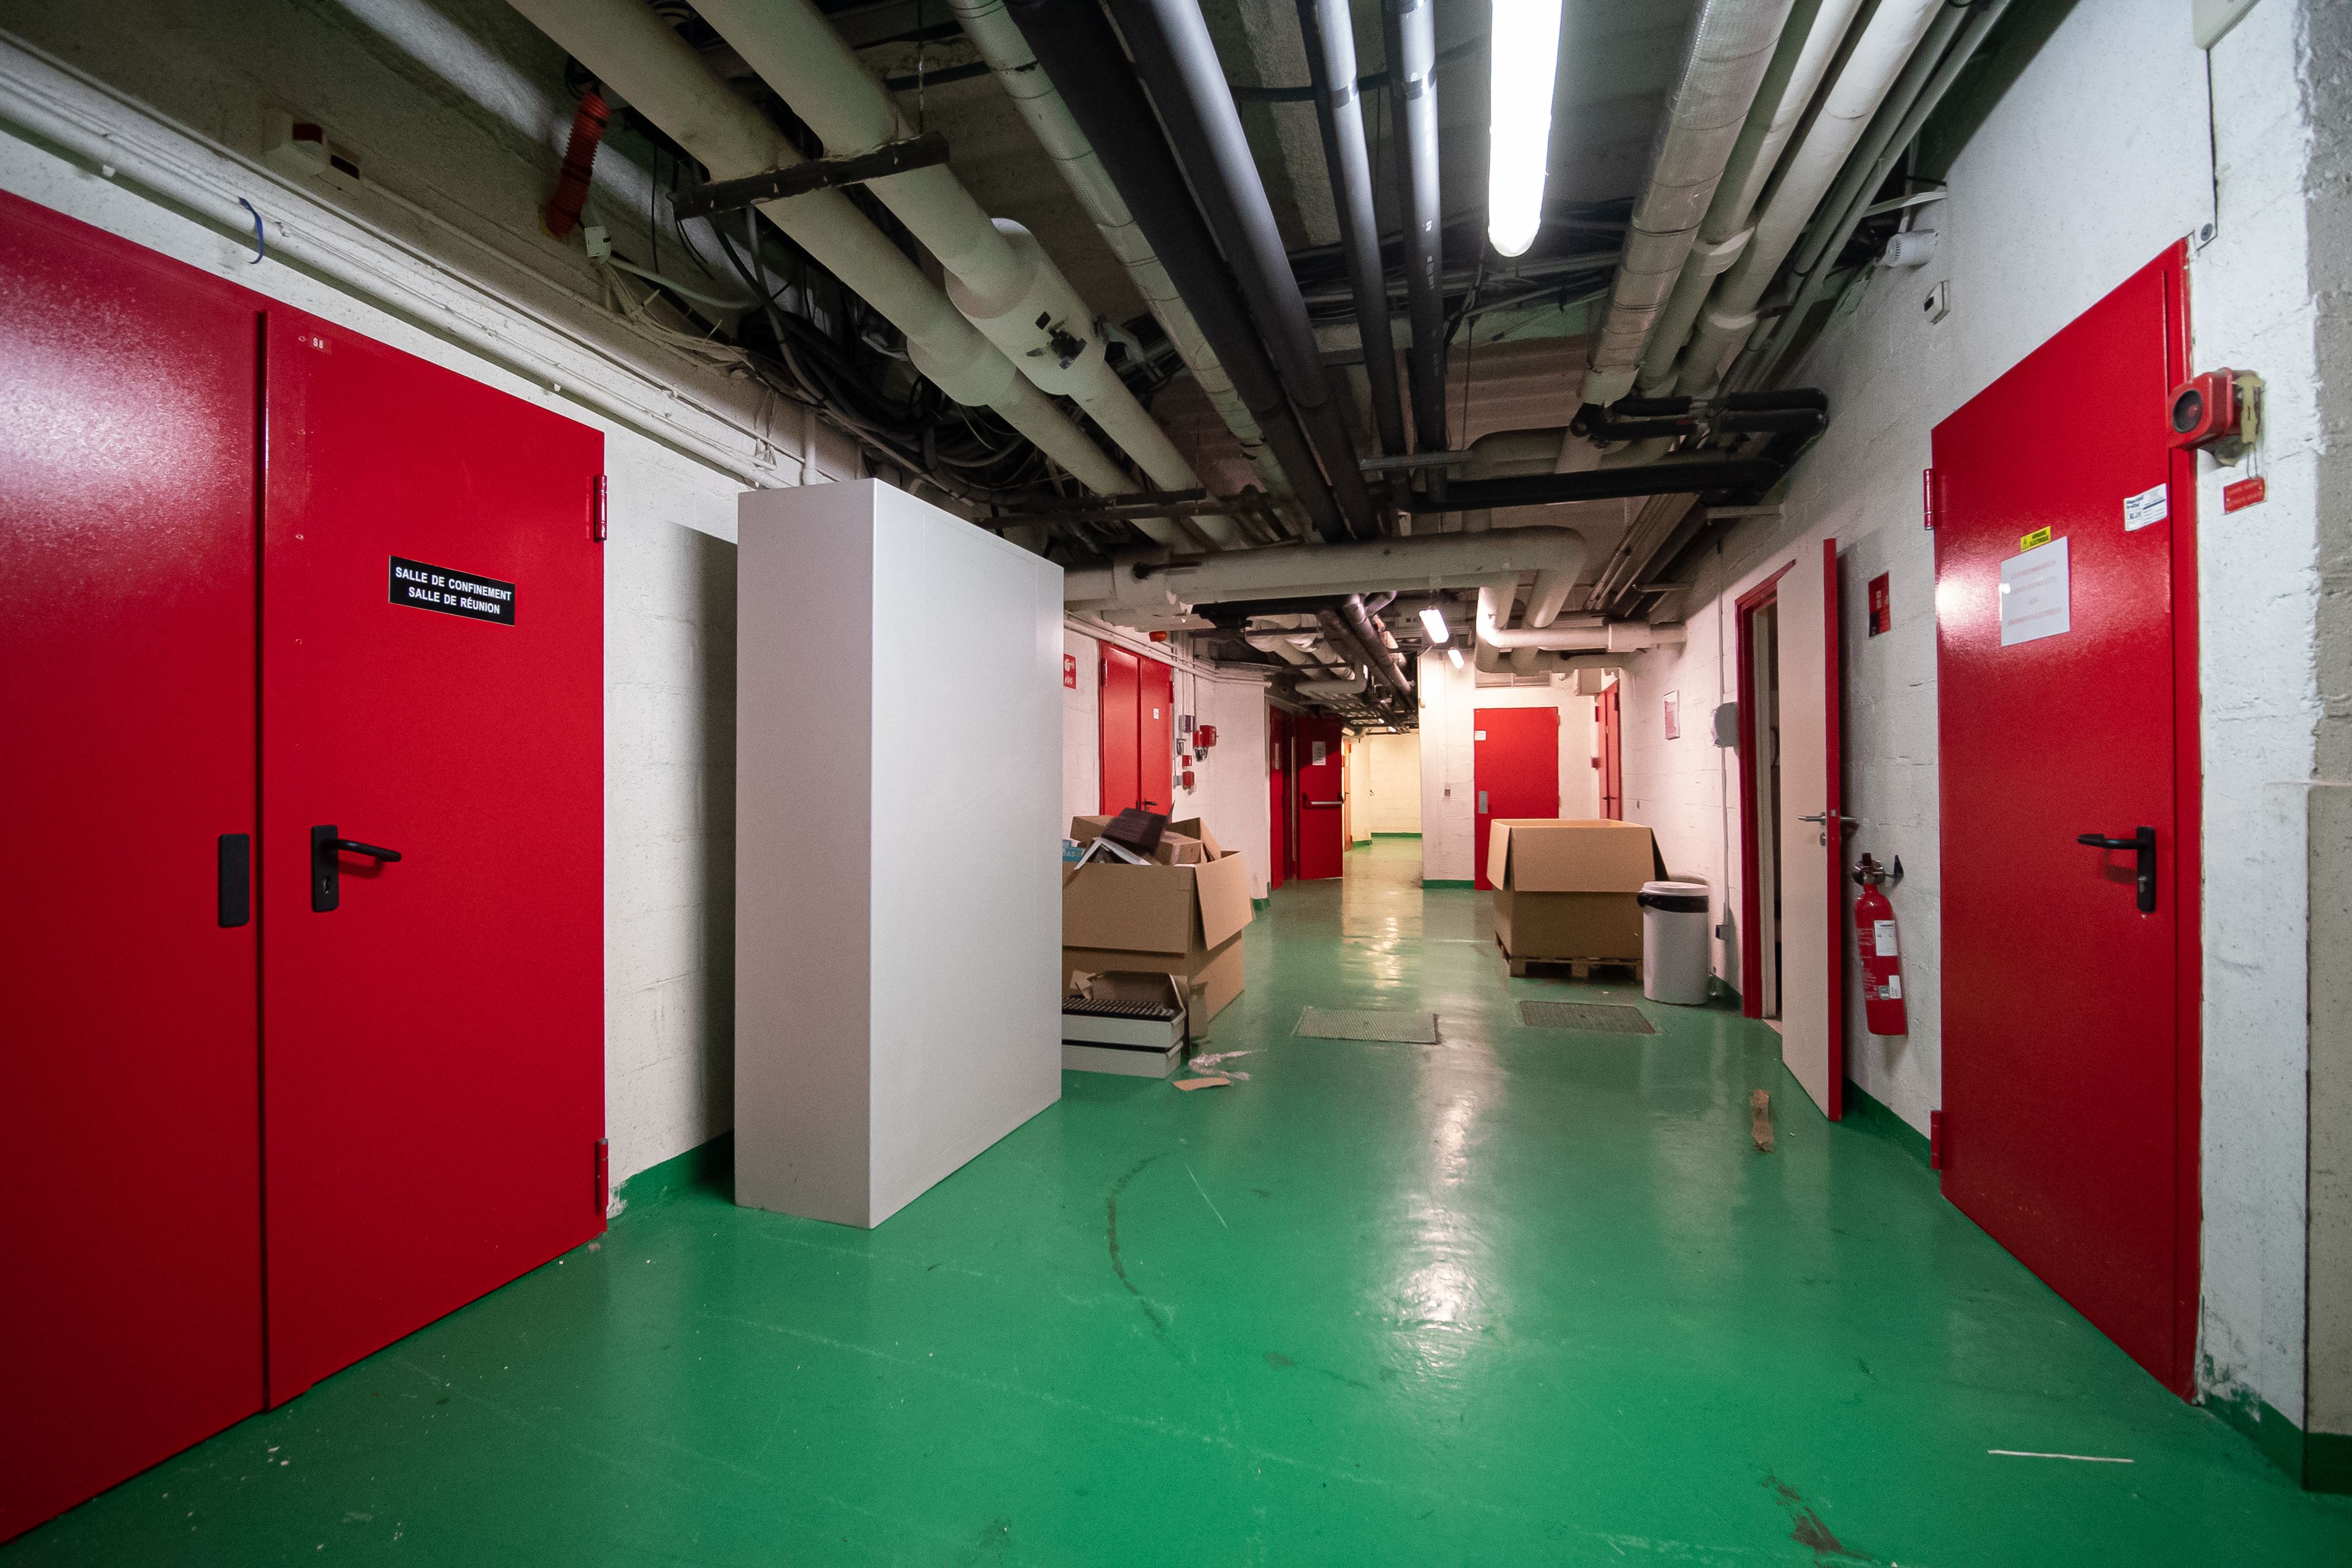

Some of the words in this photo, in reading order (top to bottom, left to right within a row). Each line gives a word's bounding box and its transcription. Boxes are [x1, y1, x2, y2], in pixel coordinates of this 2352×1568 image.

[395, 567, 428, 583] SALLE
[431, 575, 445, 587] DE
[448, 579, 512, 601] CONFINEMENT
[409, 586, 440, 602] SALLE
[443, 594, 457, 605] DE
[460, 597, 500, 614] RÉUNION
